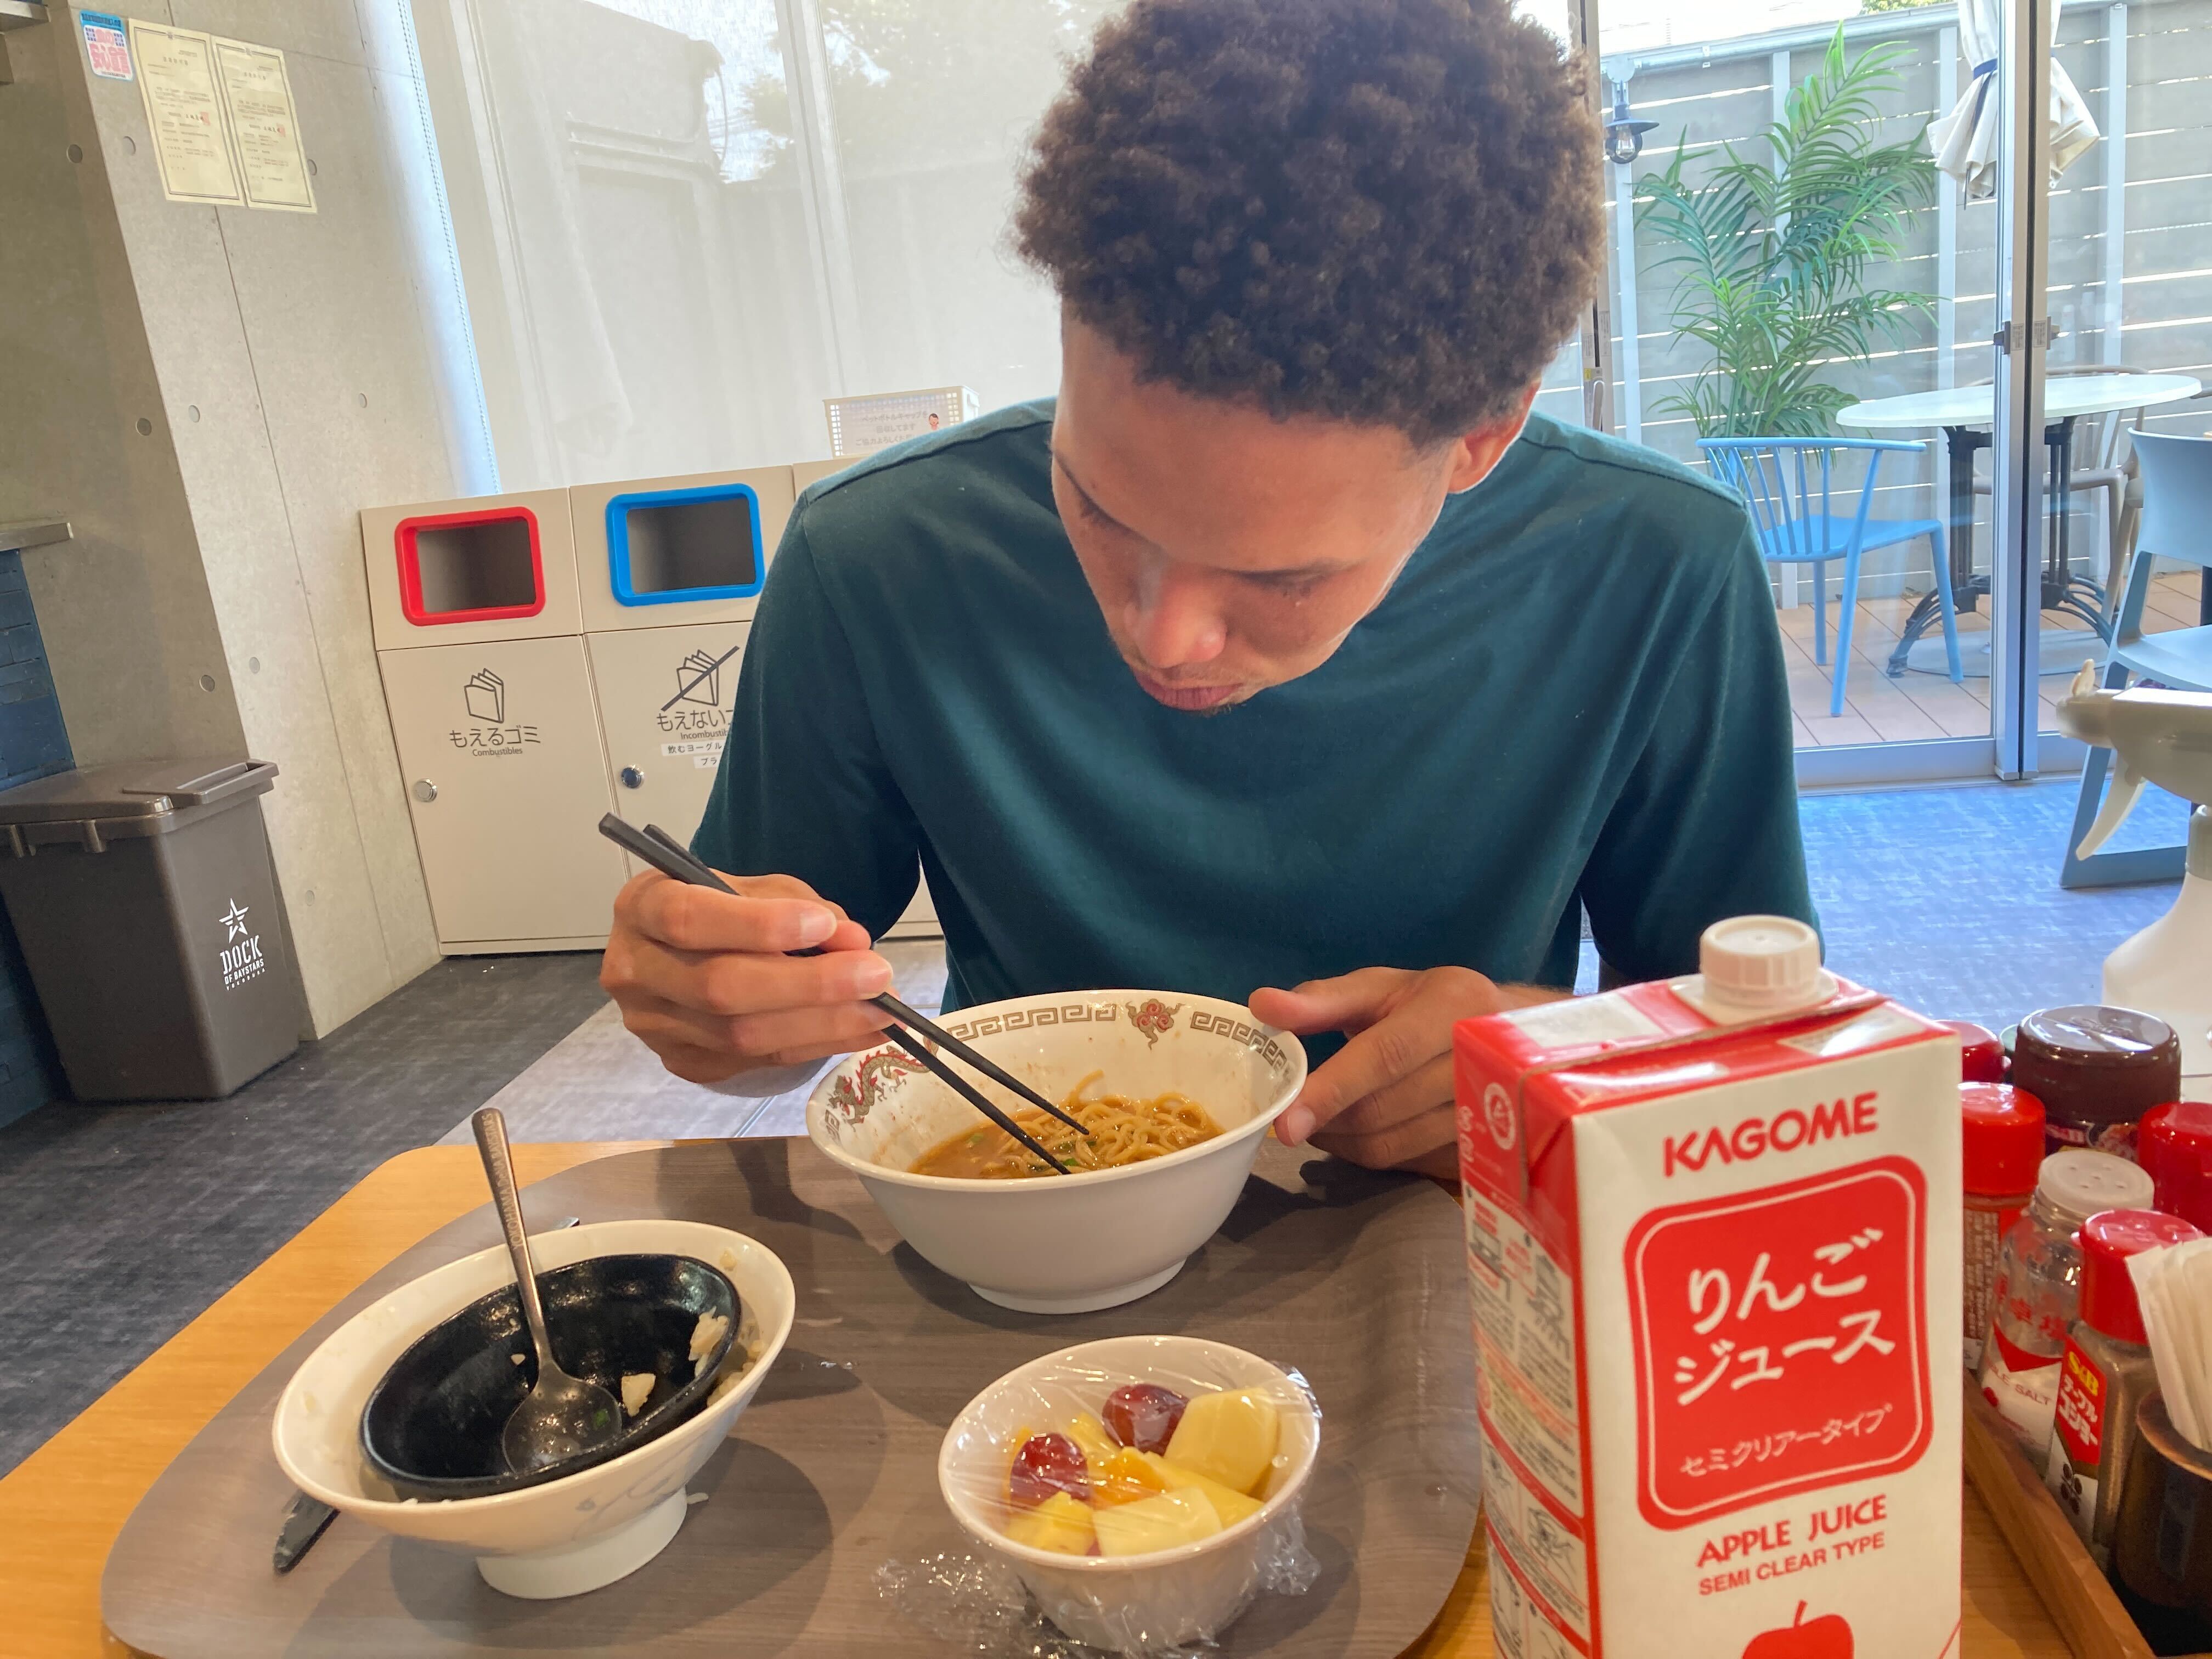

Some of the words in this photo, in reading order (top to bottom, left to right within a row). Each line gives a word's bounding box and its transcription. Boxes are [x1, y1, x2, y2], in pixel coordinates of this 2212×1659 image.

[449, 725, 541, 748] もえるゴミ
[472, 747, 523, 757] Combustibles
[668, 742, 722, 754] 飲むヨーグル
[220, 935, 262, 975] DOCK
[224, 975, 233, 985] OF
[234, 958, 264, 980] BAYSTARS
[1663, 1091, 1879, 1178] KAGOME
[499, 1187, 524, 1251] YOKOHAMA
[1688, 1227, 1884, 1335] りんご
[1674, 1309, 1896, 1406] ジュース
[2015, 1383, 2051, 1406] SALT
[1679, 1402, 1893, 1477] セミクリアータイプ
[1696, 1520, 1792, 1568] APPLE
[1808, 1494, 1887, 1542] JUICE
[1699, 1567, 1751, 1596] SEMI
[1756, 1548, 1827, 1581] CLEAR
[1832, 1531, 1886, 1561] TYPE
